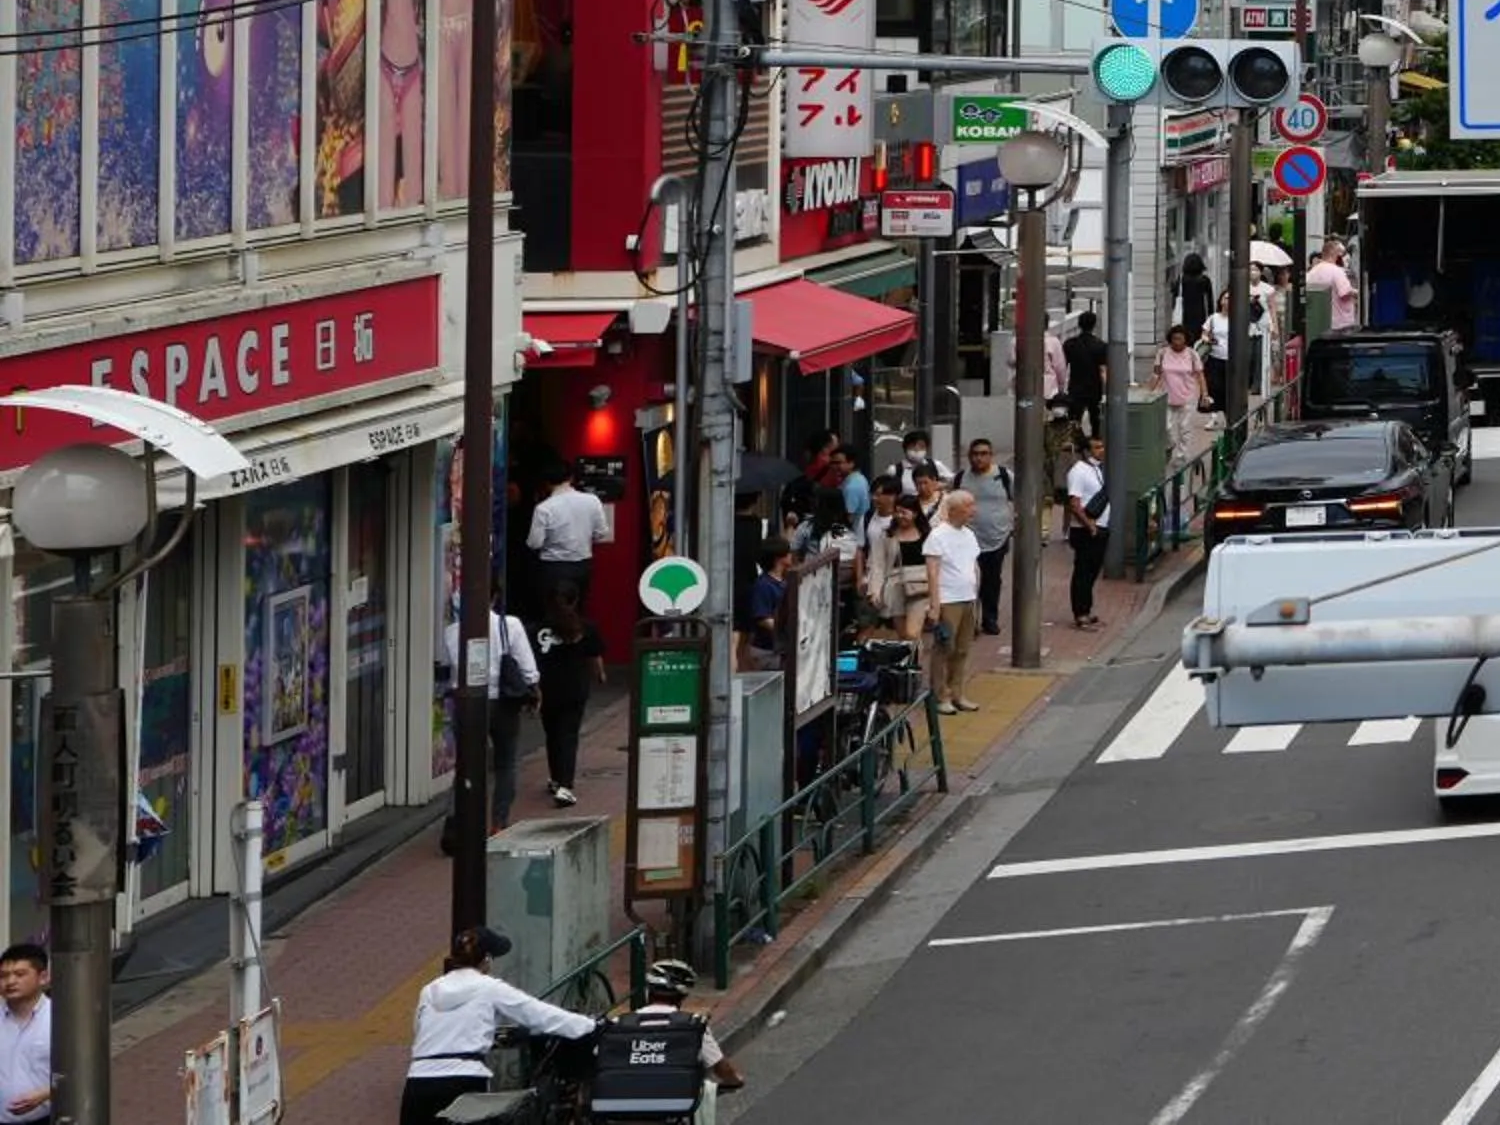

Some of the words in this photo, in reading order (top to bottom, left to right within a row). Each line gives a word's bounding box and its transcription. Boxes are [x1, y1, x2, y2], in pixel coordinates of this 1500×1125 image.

[1287, 107, 1317, 130] 40
[956, 125, 1021, 138] KOBAN
[803, 156, 861, 211] KYODAI
[90, 322, 290, 427] ESPACE
[315, 312, 374, 371] 日拓
[631, 1039, 667, 1052] Uber
[629, 1052, 666, 1064] Eats
